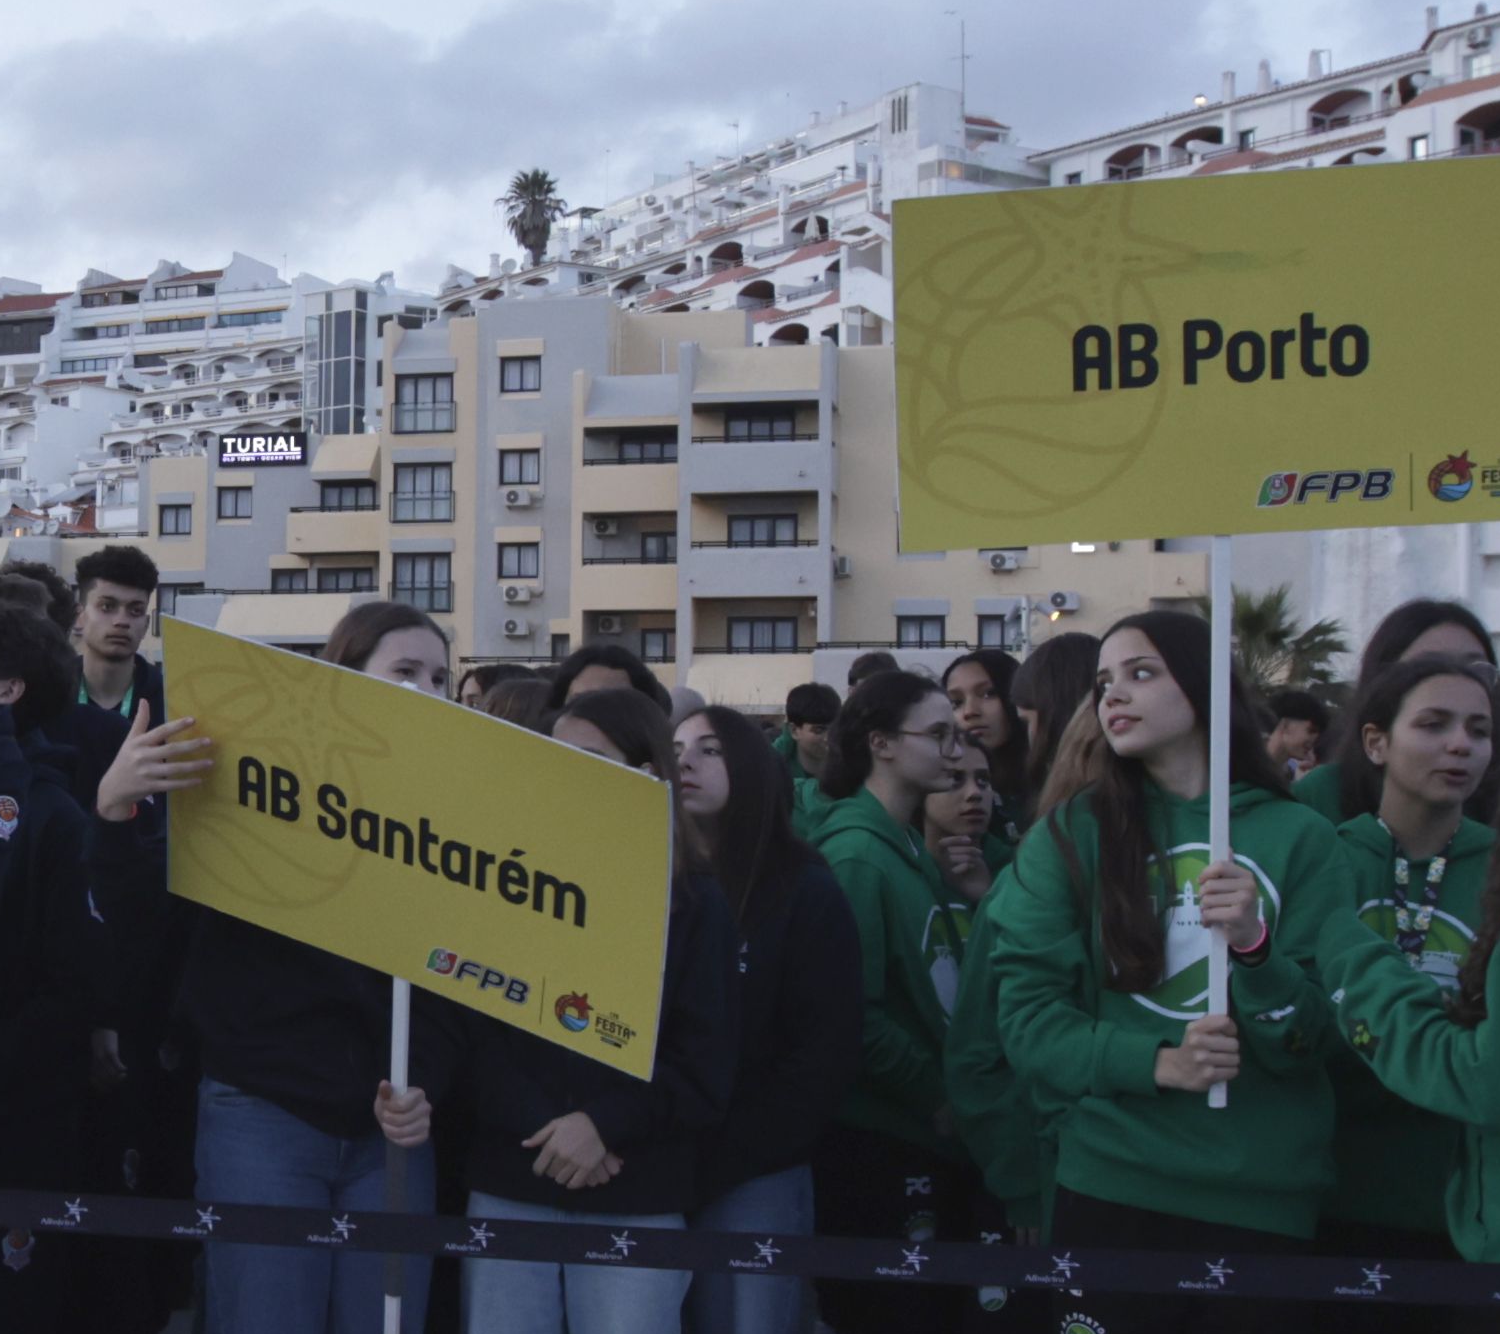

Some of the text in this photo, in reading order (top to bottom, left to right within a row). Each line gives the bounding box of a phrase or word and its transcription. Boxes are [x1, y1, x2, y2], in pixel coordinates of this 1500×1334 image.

[1072, 312, 1370, 392] AB Porto
[223, 436, 302, 453] TURIAL
[1296, 469, 1394, 503] FPB
[238, 756, 586, 928] AB Santarém
[455, 960, 529, 1005] FPB
[1025, 1273, 1065, 1284] Albufeira
